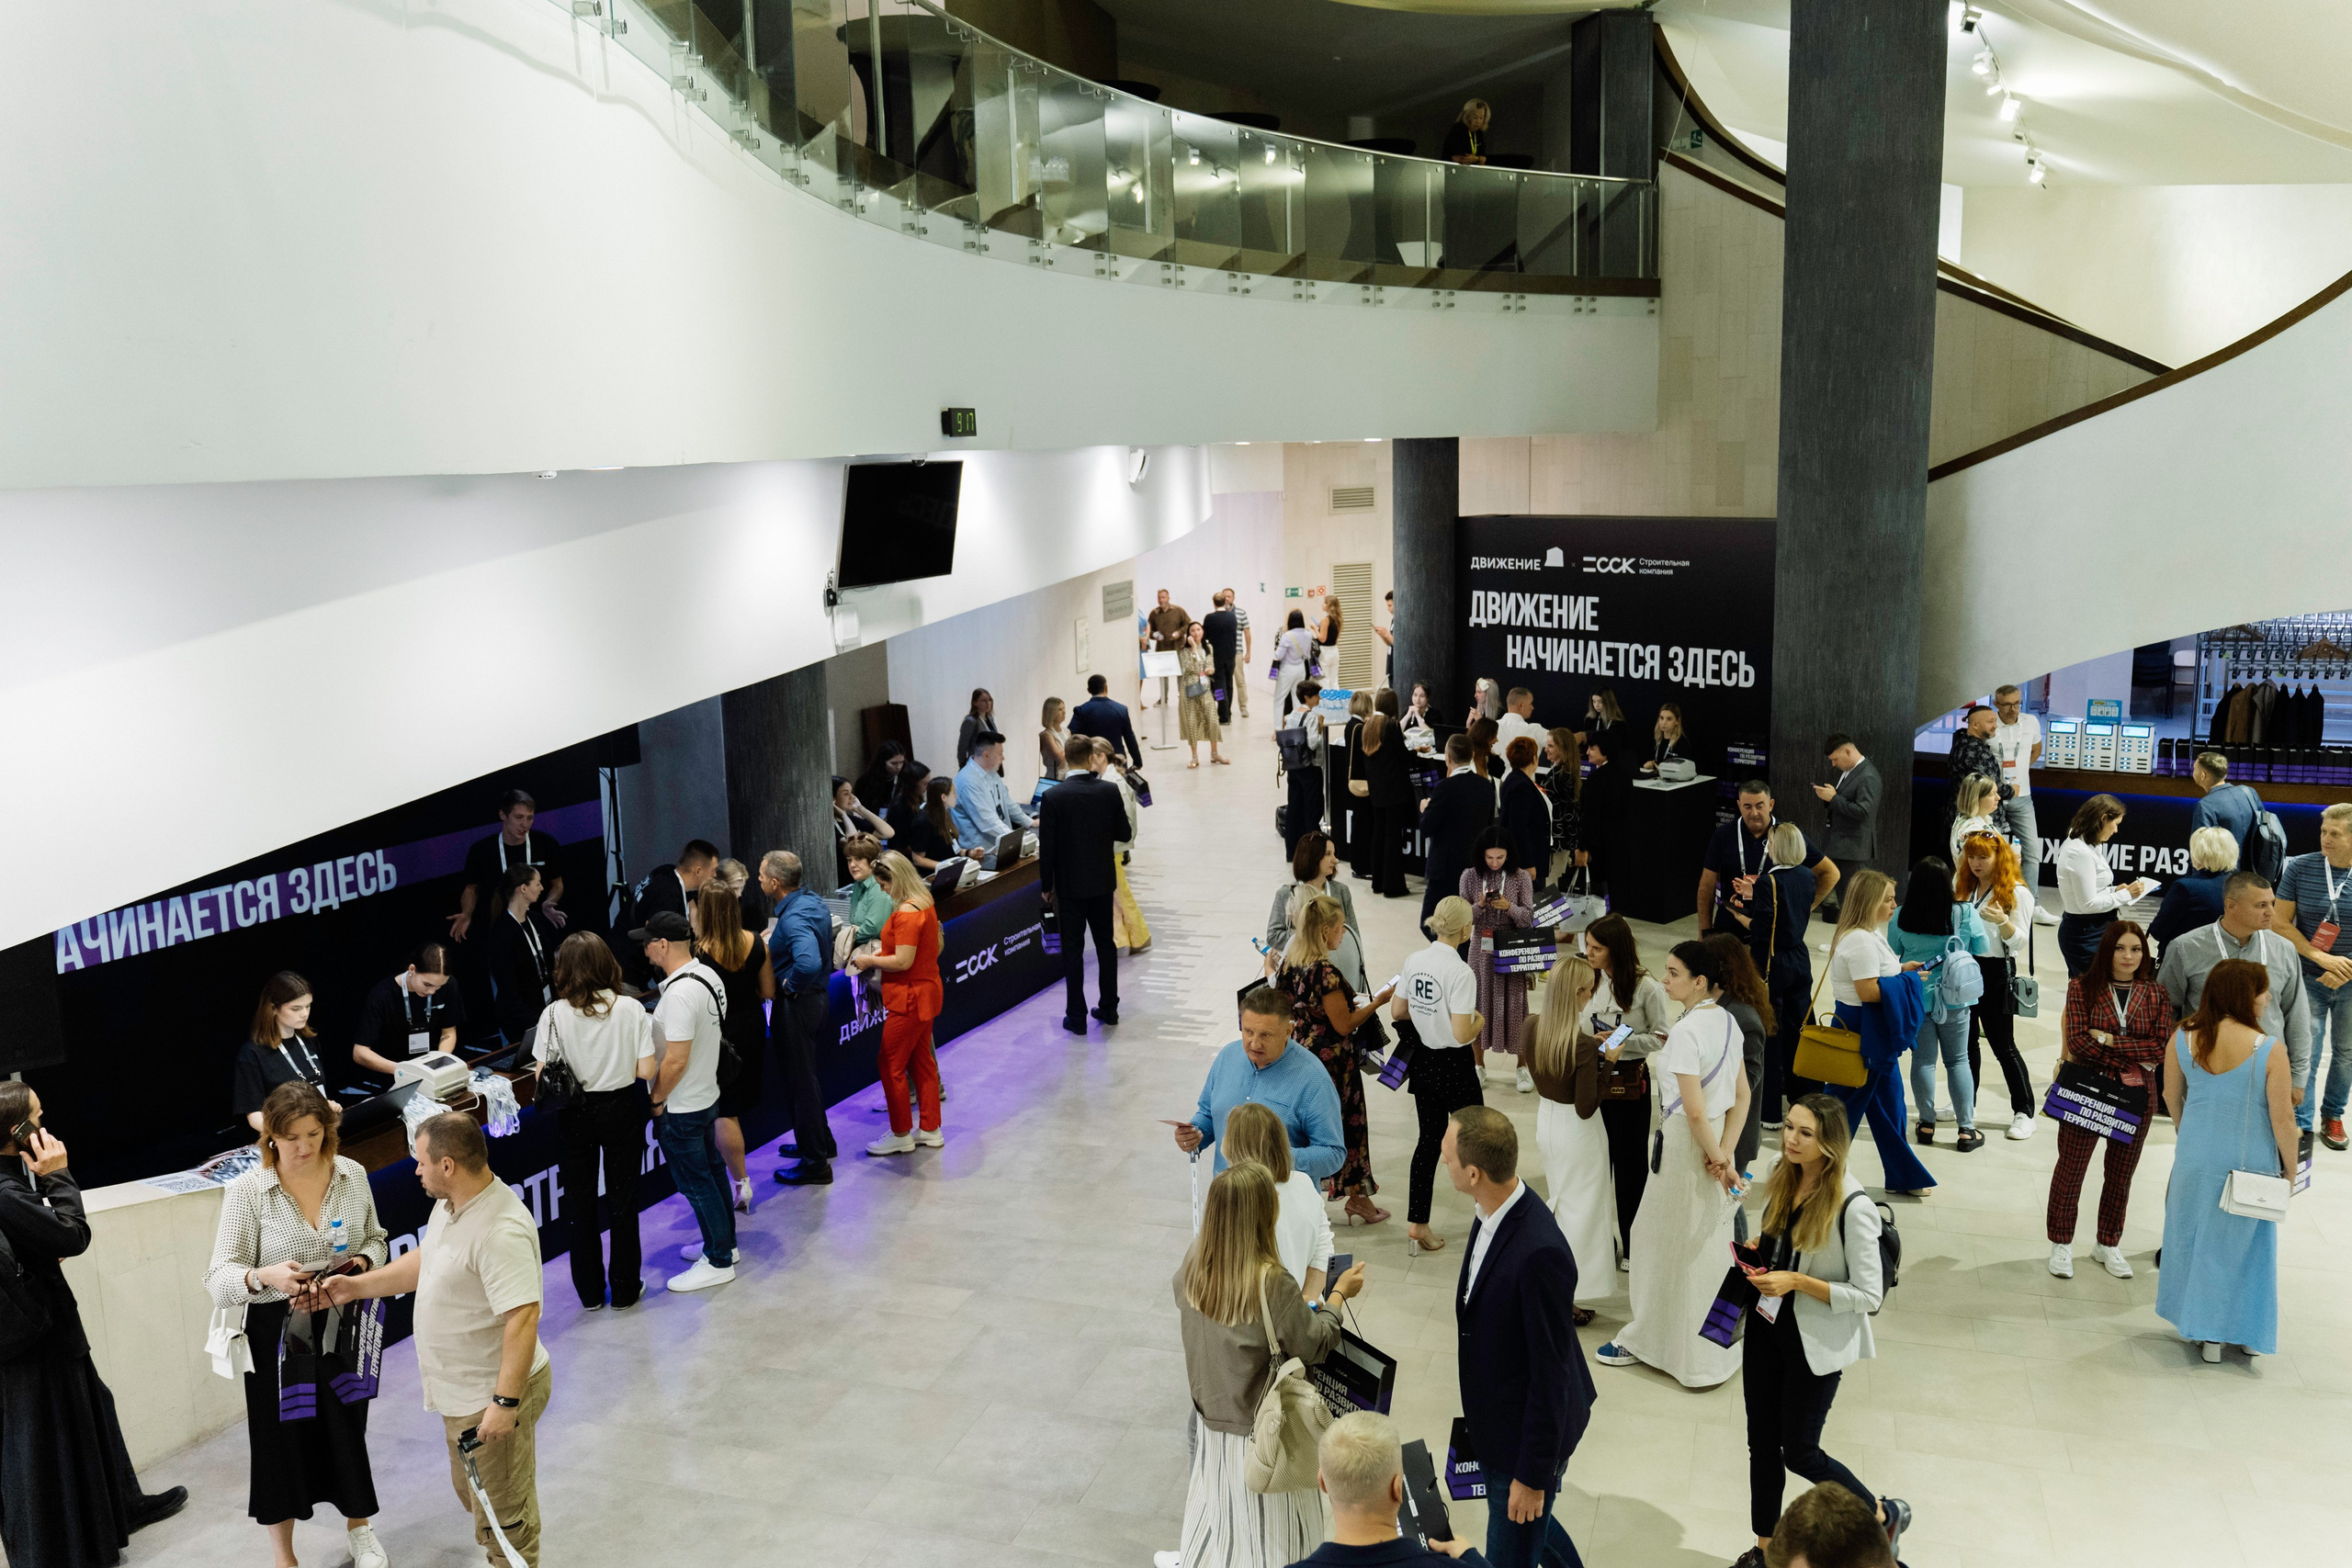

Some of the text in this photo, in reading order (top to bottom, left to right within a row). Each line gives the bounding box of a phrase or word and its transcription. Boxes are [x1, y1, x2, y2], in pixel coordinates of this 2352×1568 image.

[1470, 557, 1541, 570] ДВИЖЕНИЕ
[1639, 558, 1690, 568] Строительная
[1639, 568, 1673, 576] компания
[1469, 591, 1600, 631] ДВИЖЕНИЕ
[1507, 635, 1756, 688] НАЧИНАЕТСЯ ЗДЕСЬ
[56, 849, 397, 975] АЧИНАЕТСЯ ЗДЕСЬ
[1004, 938, 1031, 956] компания
[1498, 946, 1541, 958] КОНФЕРЕНЦИЯ
[1527, 953, 1557, 963] РАЗВИТИЮ
[1510, 961, 1545, 973] ТЕРРИТОРИЙ
[1416, 978, 1433, 1000] RE
[2057, 1087, 2117, 1116] КОНФЕРЕНЦИЯ
[2063, 1111, 2113, 1137] ТЕРРИТОРИЙ
[2079, 1106, 2137, 1135] ПО РАЗВИТИЮ
[356, 1310, 368, 1379] КОНФЕРЕНЦИЯ
[369, 1322, 383, 1379] ТЕРРИТОРИЙ
